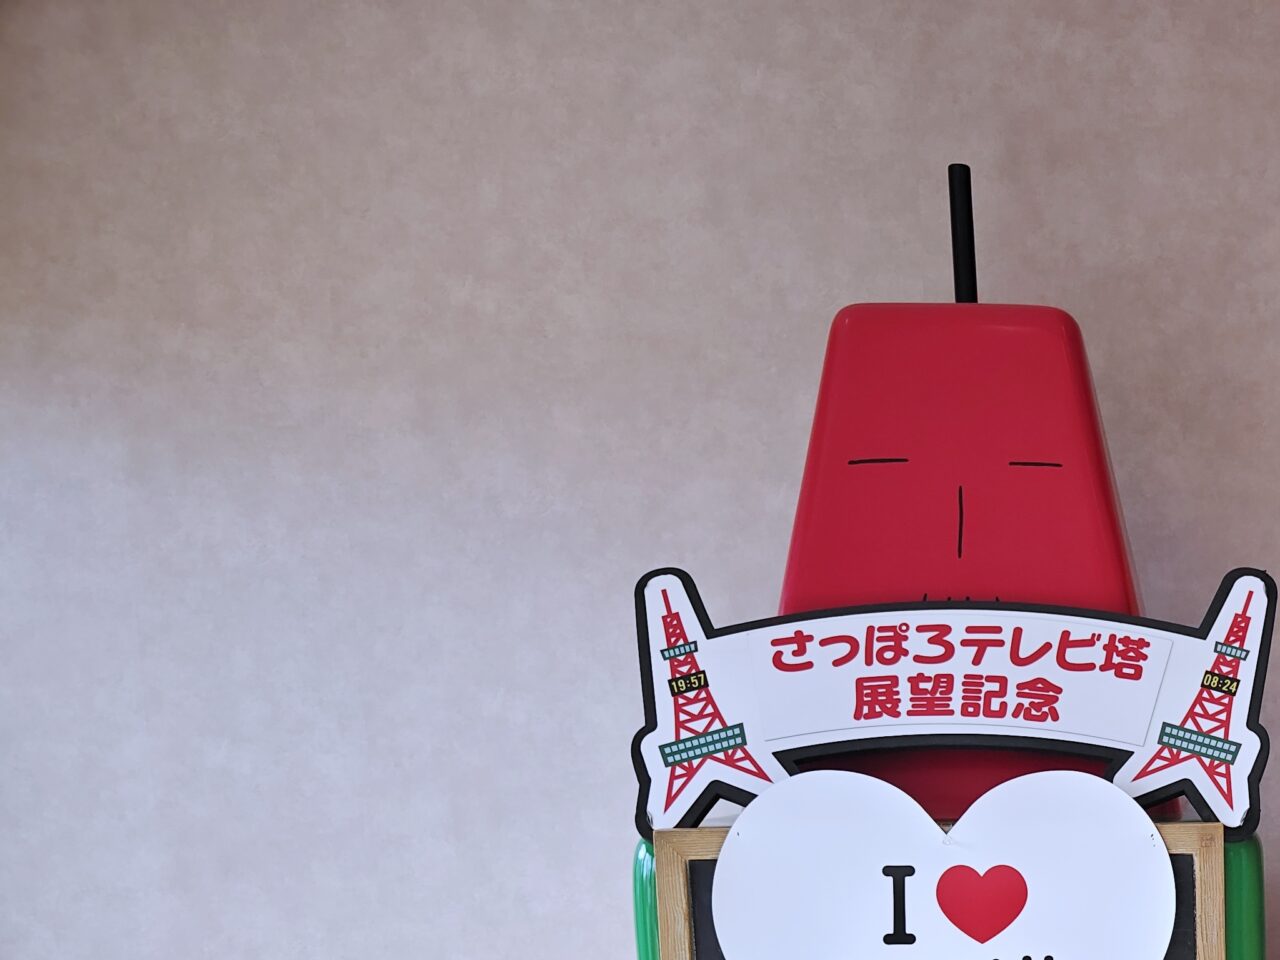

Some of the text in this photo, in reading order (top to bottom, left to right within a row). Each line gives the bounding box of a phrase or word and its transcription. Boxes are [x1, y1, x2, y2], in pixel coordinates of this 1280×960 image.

[770, 622, 1151, 681] さっぽろテレビ塔
[671, 673, 705, 693] 19:57
[853, 674, 1063, 723] 展望記念
[1203, 674, 1238, 693] 08:24
[882, 865, 916, 945] I
